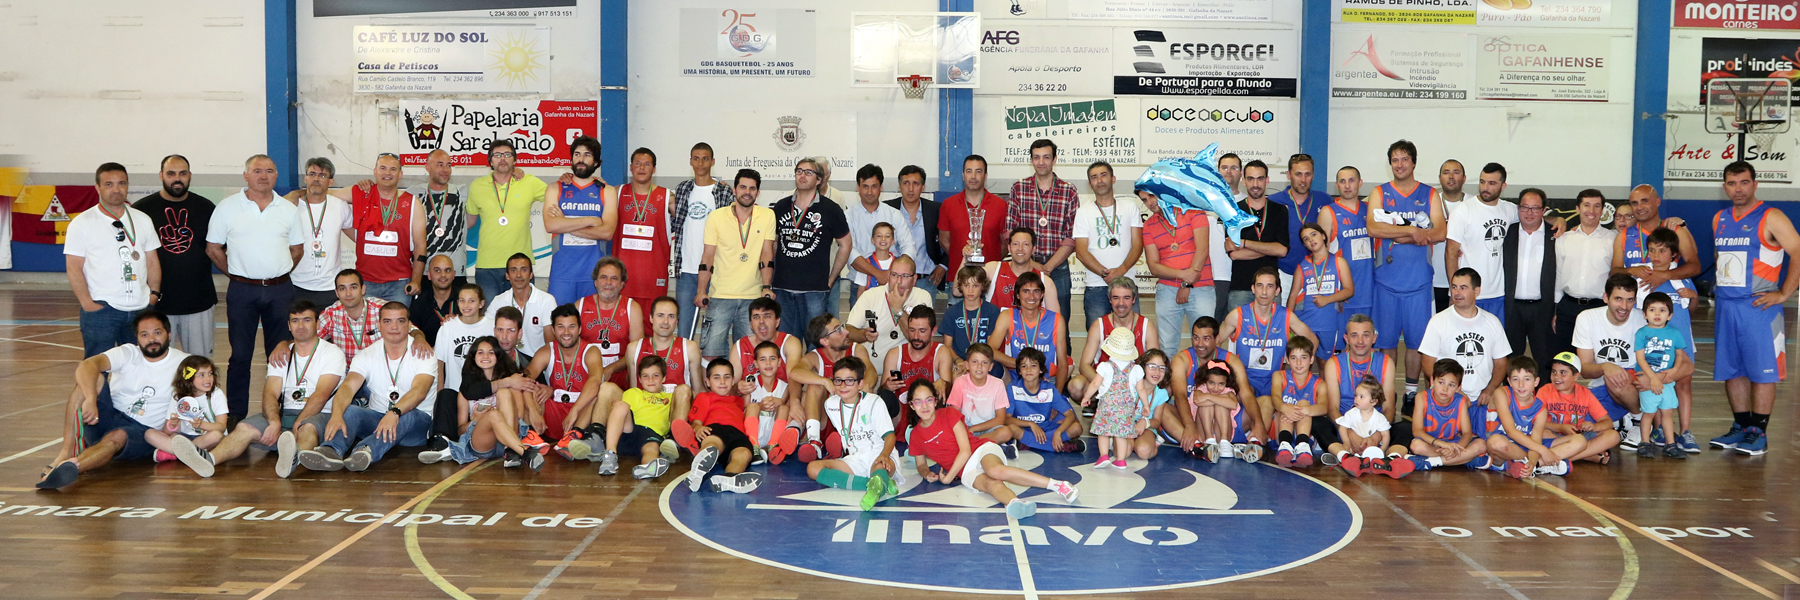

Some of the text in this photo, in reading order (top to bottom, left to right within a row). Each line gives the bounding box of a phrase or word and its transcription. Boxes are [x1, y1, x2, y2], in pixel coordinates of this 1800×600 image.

[1685, 3, 1797, 21] MONTEIRO
[720, 9, 756, 34] 25
[358, 30, 488, 43] CAFÉ LUZ DO SOL
[981, 31, 1019, 45] AFG
[1170, 43, 1279, 61] ESPORGEL
[399, 62, 439, 70] Petiscos
[1503, 56, 1603, 68] GAFANHENSE
[1708, 58, 1793, 73] probindes
[1335, 70, 1377, 80] argentea
[1507, 74, 1539, 82] Diferença
[1138, 78, 1152, 86] De
[1155, 78, 1198, 89] Portugal
[1202, 80, 1223, 89] para
[1237, 79, 1272, 88] Mundo
[452, 104, 539, 130] Papelaria
[1005, 105, 1047, 122] Nova
[1008, 125, 1116, 140] cabeleireiros
[1093, 135, 1135, 147] ESTÉTICA
[1668, 144, 1786, 160] Arte & Som
[726, 156, 853, 169] Junta de Freguesia da Nazaré
[561, 202, 600, 211] GAFANHA
[1483, 218, 1507, 229] MASTER
[454, 336, 476, 345] MAST
[1455, 332, 1485, 343] MASTER
[1600, 338, 1631, 351] MASTER
[178, 505, 508, 528] Municipal
[522, 511, 604, 529] de
[1431, 526, 1754, 541] o mar por
